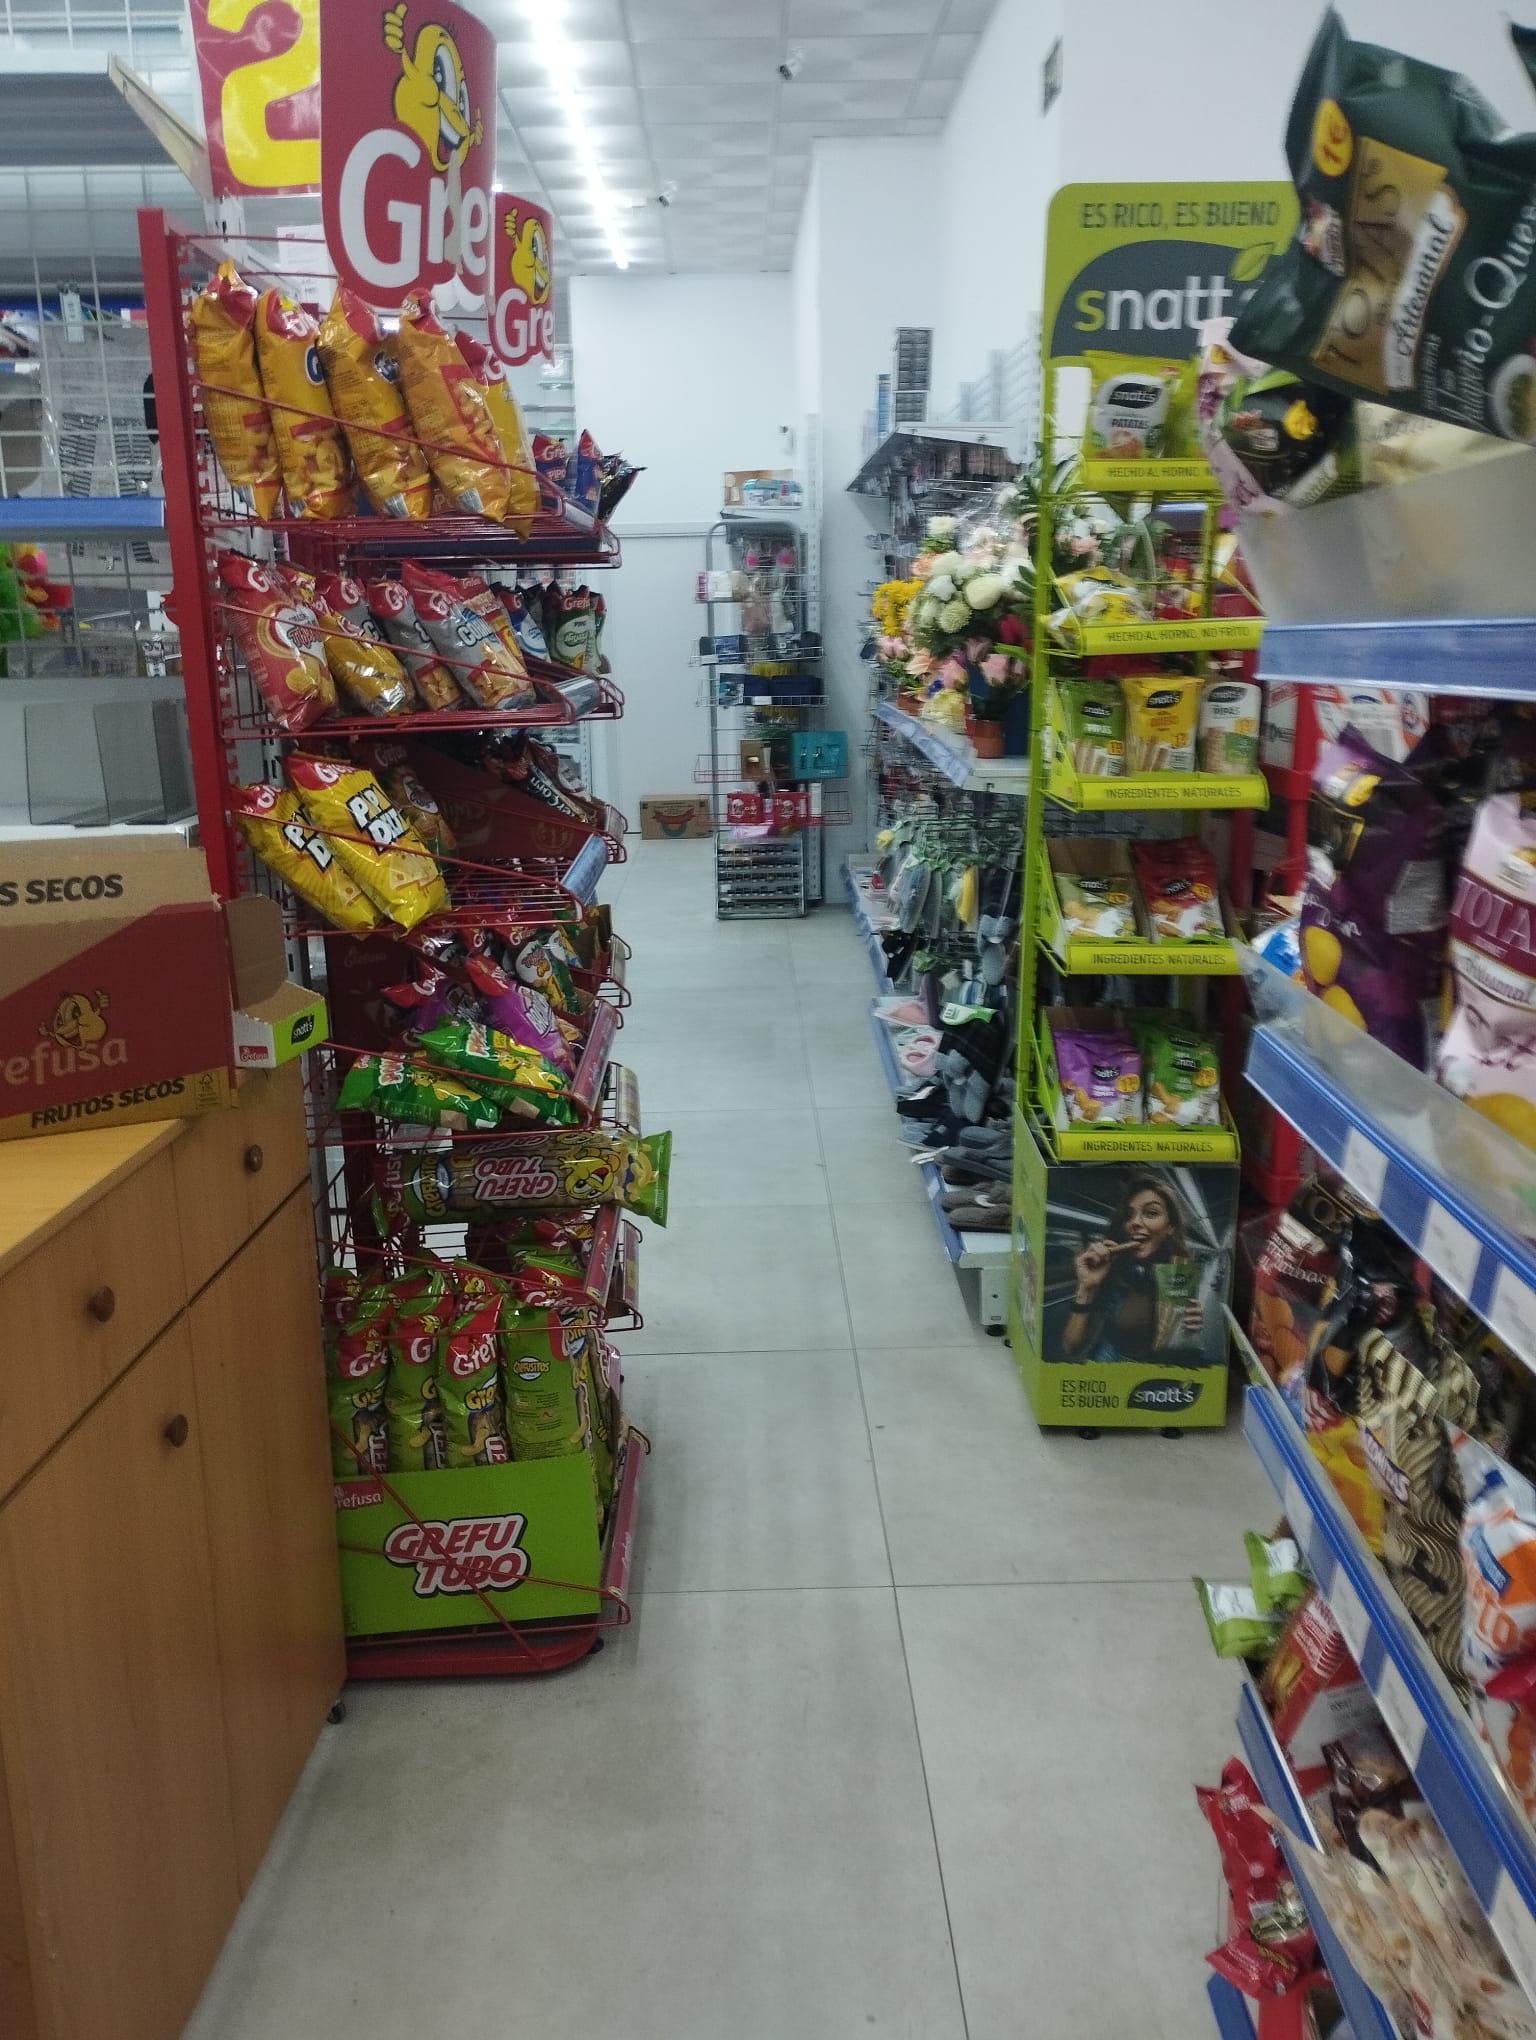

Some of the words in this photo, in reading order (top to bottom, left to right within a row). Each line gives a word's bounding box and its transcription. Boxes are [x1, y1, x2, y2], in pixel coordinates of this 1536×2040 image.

[1081, 203, 1106, 229] ES
[1175, 202, 1201, 228] ES
[1206, 201, 1281, 227] BUENO
[1105, 787, 1180, 800] INGREDIENTES
[1183, 786, 1242, 799] NATURALES
[25, 873, 124, 904] SECOS
[1093, 953, 1165, 965] INGREDIENTES
[1168, 953, 1226, 965] NATURALES
[0, 1037, 129, 1087] efusa
[31, 1091, 114, 1129] FRUTOS
[118, 1077, 186, 1104] SECOS
[1083, 1139, 1153, 1152] INGREDIENTES
[1157, 1140, 1214, 1152] NATURALES
[475, 1156, 543, 1177] TUBO
[475, 1174, 558, 1200] GREFU
[1061, 1380, 1076, 1394] ES
[1079, 1380, 1107, 1394] RICO
[1061, 1394, 1076, 1409] ES
[1078, 1394, 1120, 1409] BUENO
[336, 1490, 382, 1509] refusa
[388, 1518, 520, 1558] GREFU
[417, 1551, 523, 1591] TUBO
